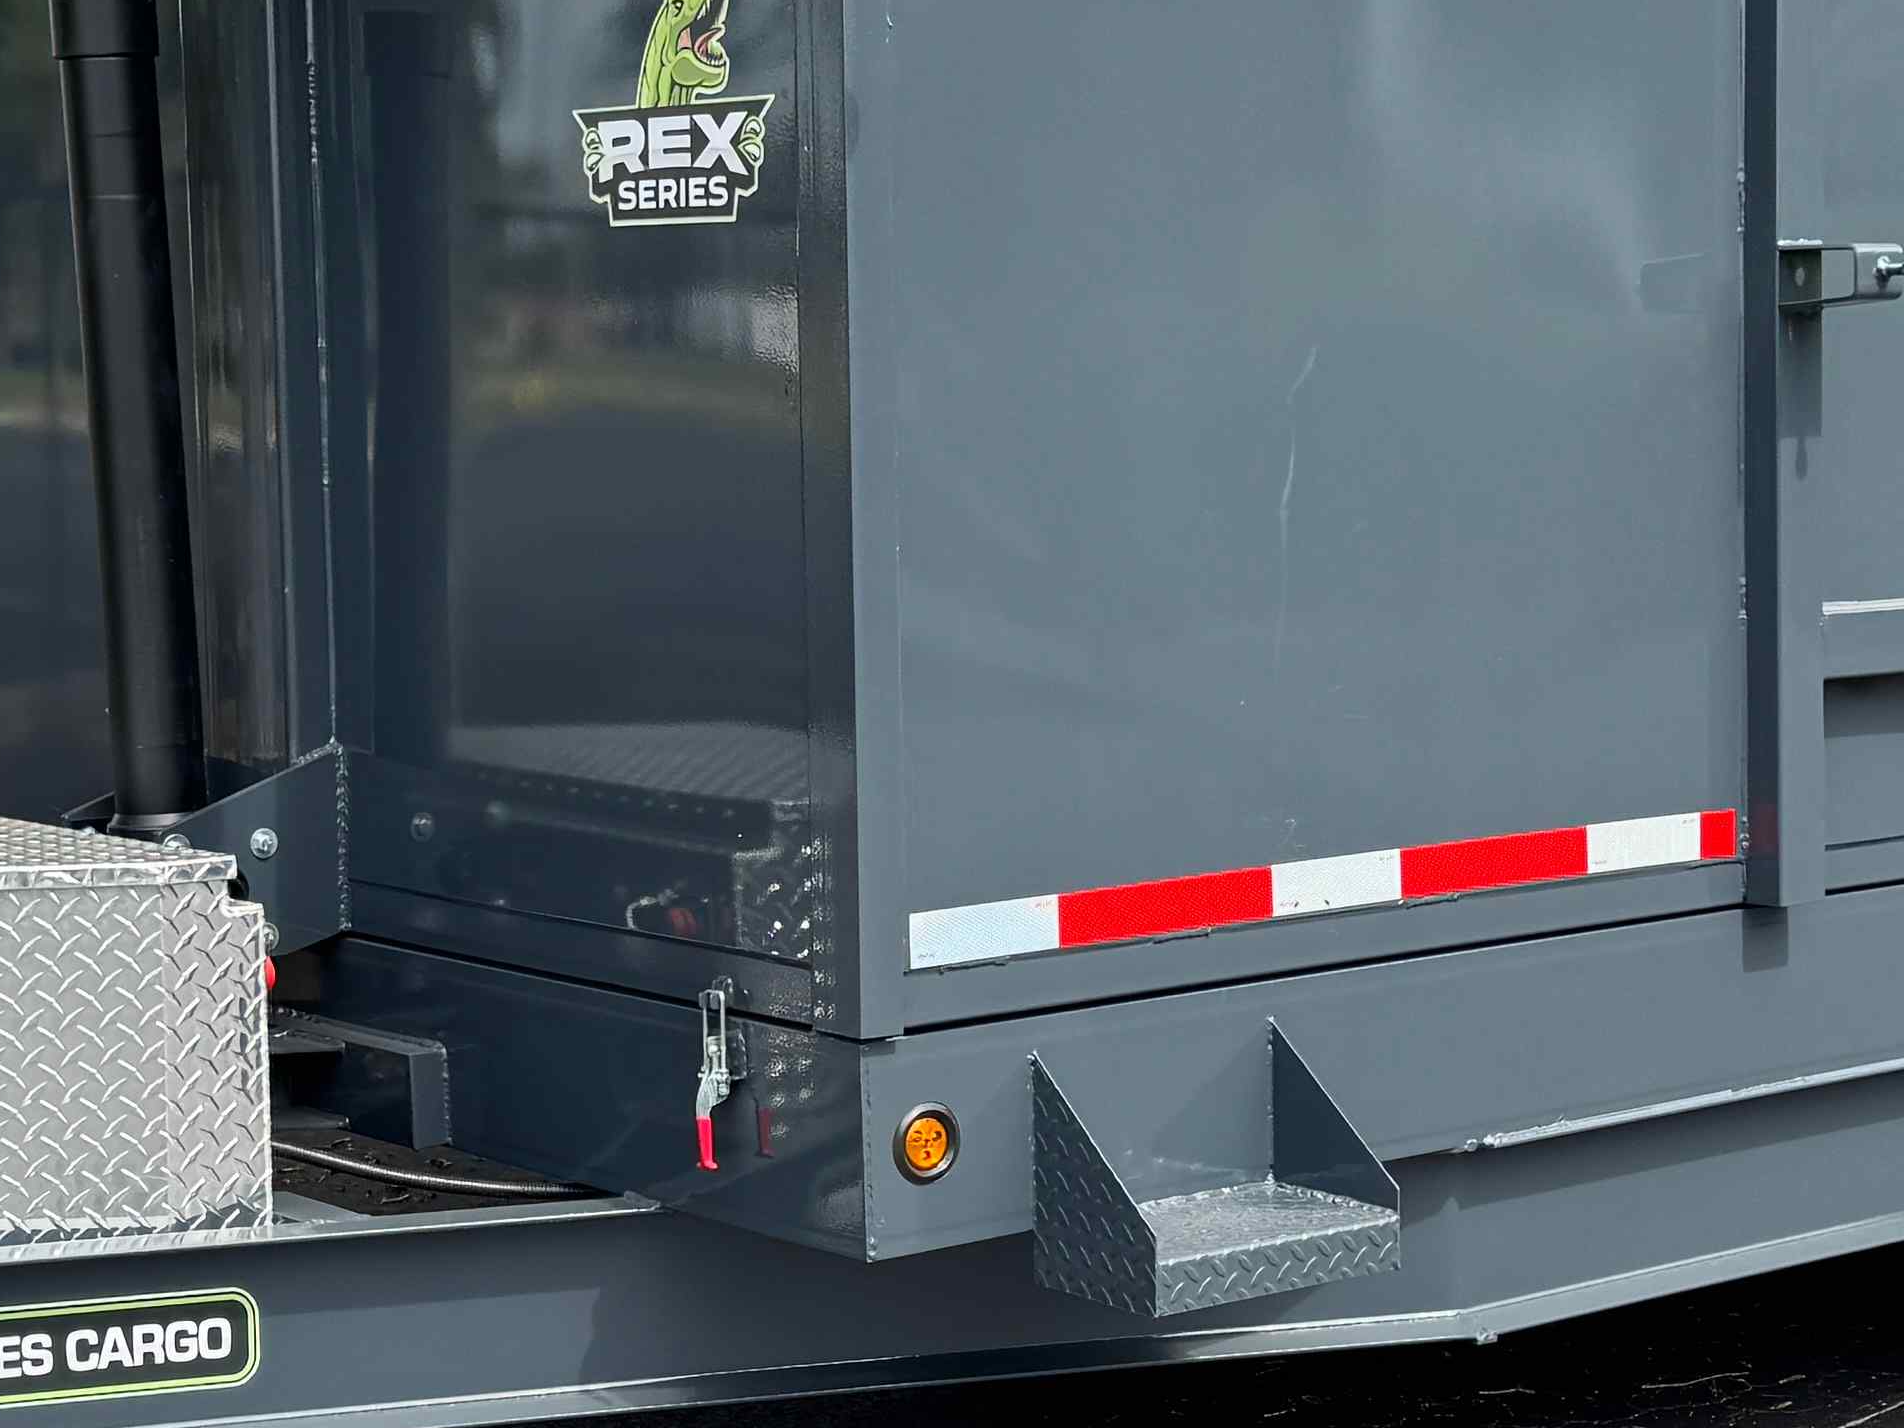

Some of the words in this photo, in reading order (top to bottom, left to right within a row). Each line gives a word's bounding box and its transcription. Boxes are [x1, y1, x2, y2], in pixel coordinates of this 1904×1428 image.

[598, 111, 749, 183] REX
[617, 175, 729, 211] SERIES
[65, 1317, 232, 1372] CARGO
